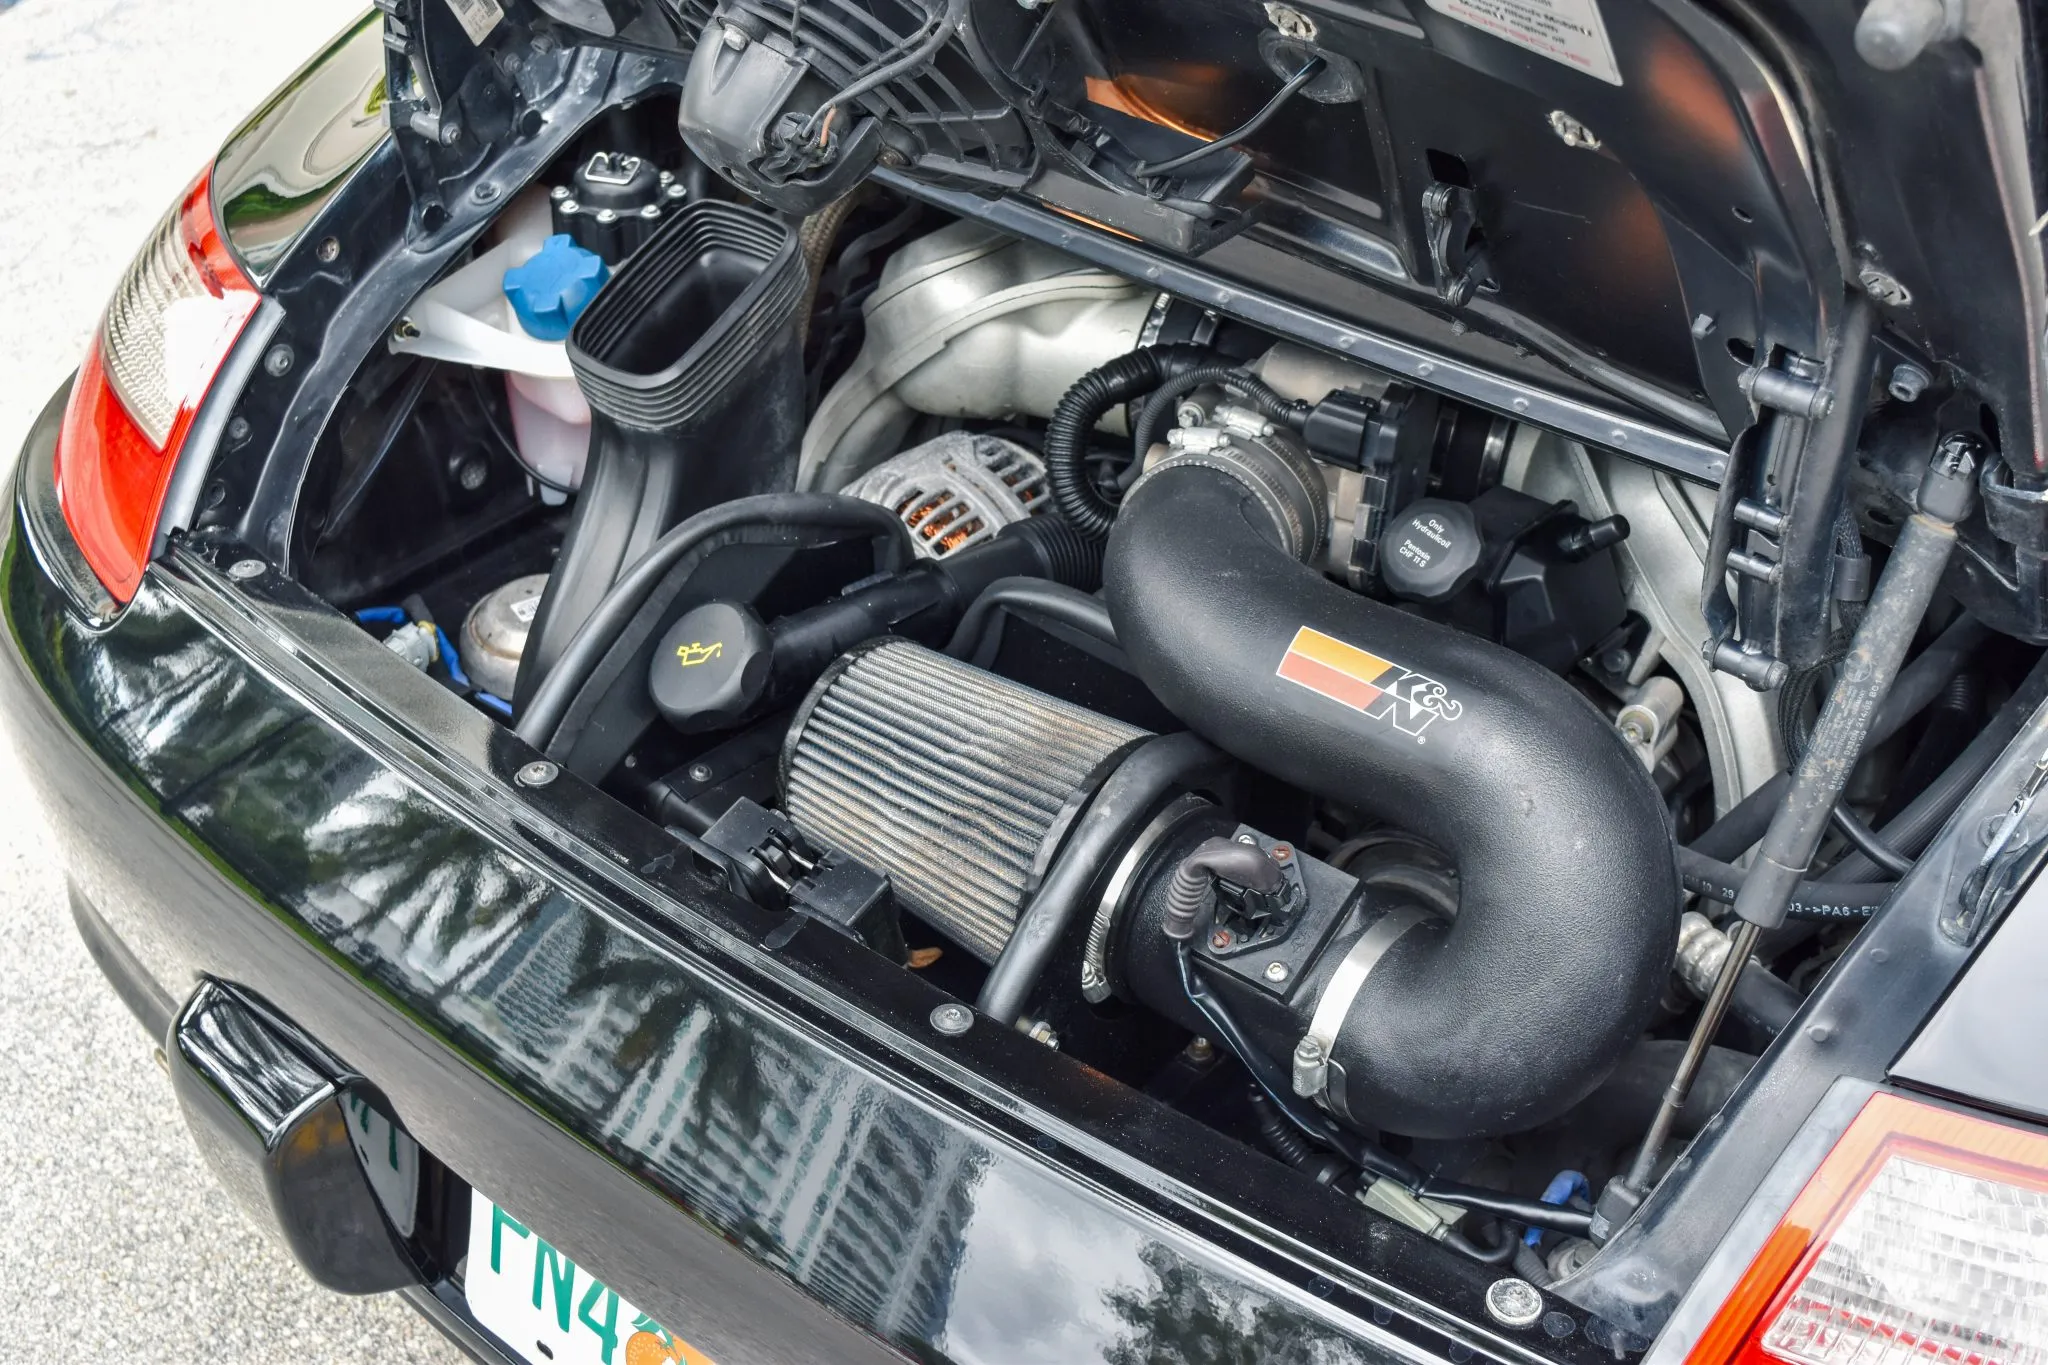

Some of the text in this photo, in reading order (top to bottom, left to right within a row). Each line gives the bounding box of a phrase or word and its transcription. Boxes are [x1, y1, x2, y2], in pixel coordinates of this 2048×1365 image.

[1412, 518, 1452, 549] Hydraulicoil
[1428, 519, 1446, 534] Only
[1399, 546, 1427, 568] CHF 11 S
[1403, 539, 1431, 561] Pentosin
